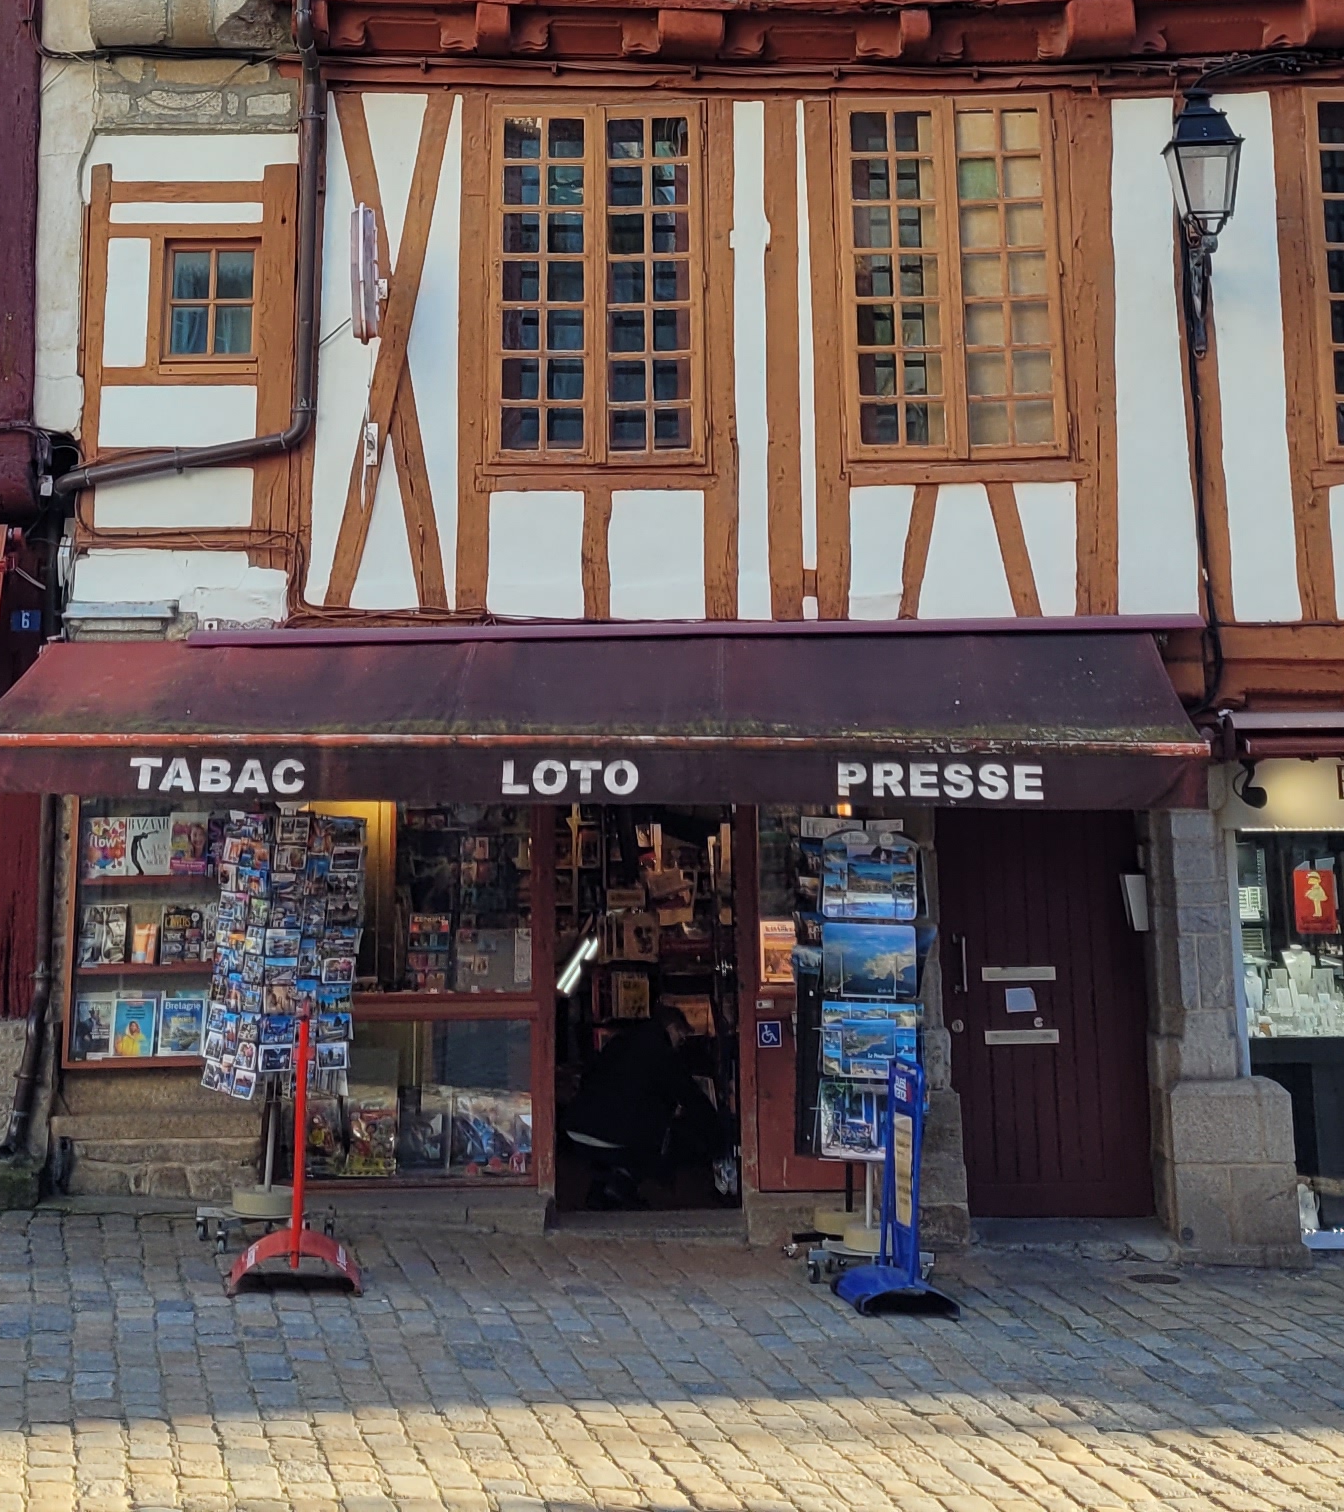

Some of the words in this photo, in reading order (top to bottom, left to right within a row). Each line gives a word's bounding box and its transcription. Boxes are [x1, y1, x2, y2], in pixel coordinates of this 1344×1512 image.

[20, 611, 31, 629] 6
[129, 757, 306, 795] TABAC
[501, 759, 639, 796] LOTO
[837, 761, 1045, 801] PRESSE
[89, 833, 116, 848] flow
